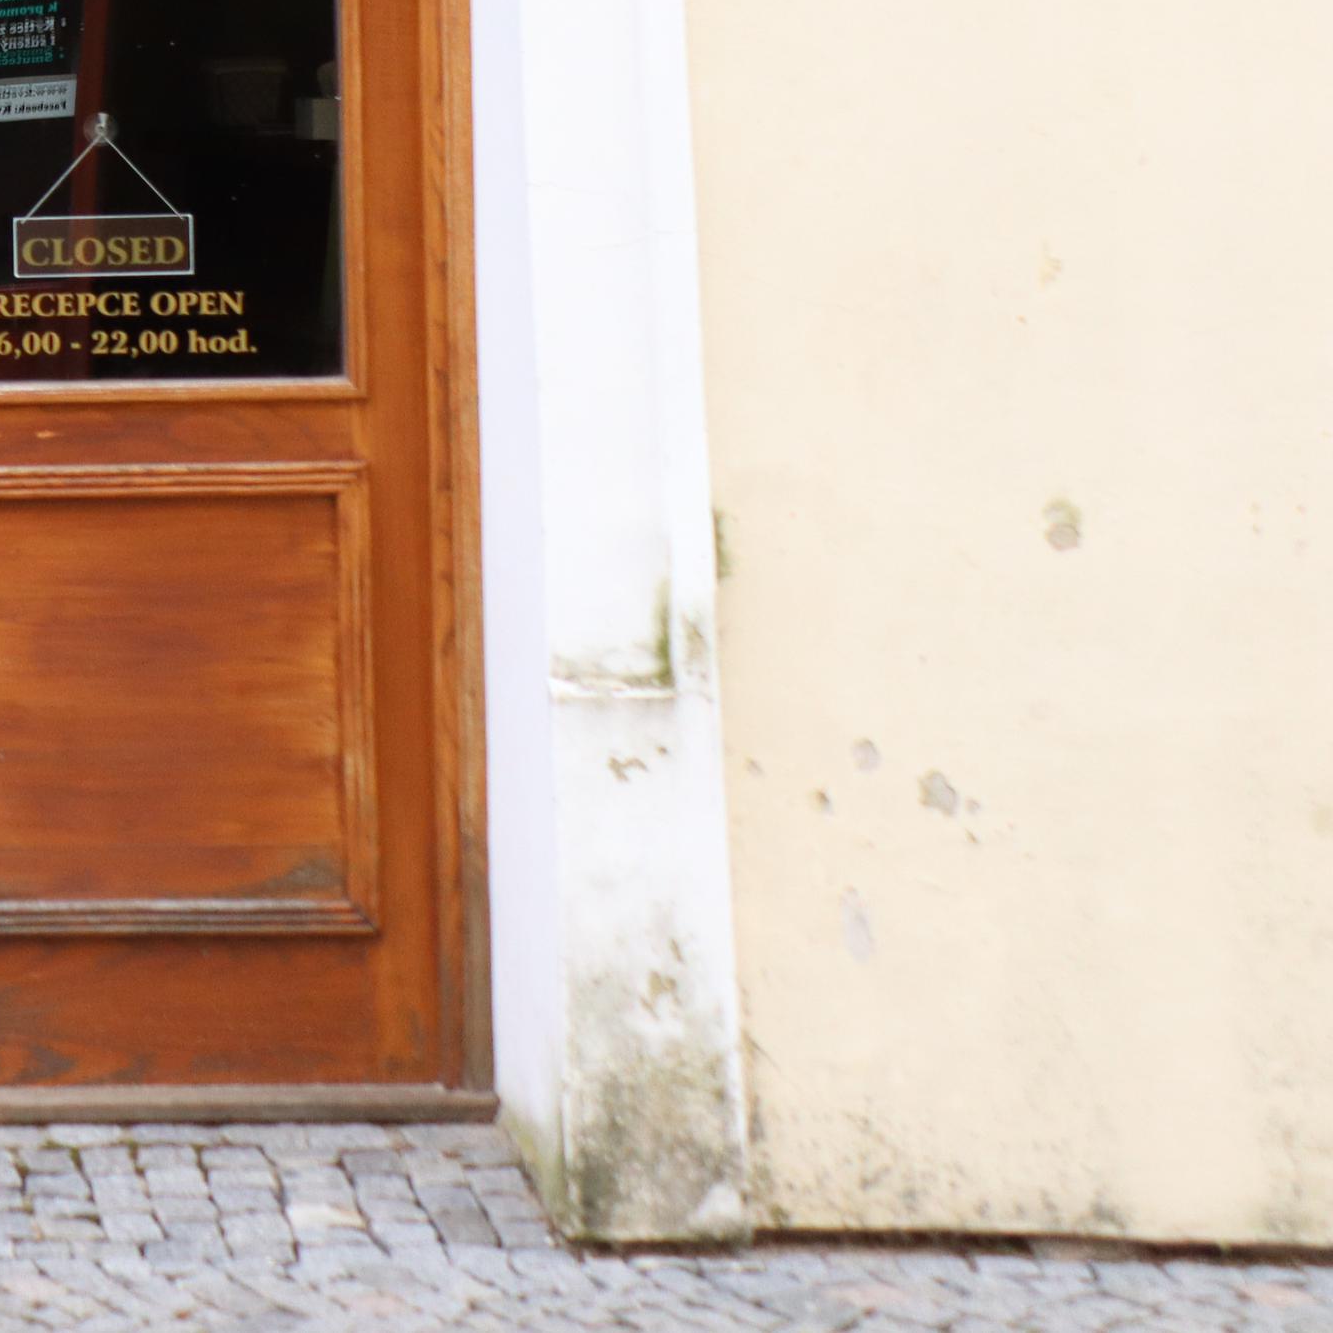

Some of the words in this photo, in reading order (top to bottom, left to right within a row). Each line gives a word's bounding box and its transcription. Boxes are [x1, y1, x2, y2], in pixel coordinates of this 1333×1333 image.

[21, 235, 186, 267] CLOSED
[149, 290, 245, 317] OPEN
[90, 329, 179, 359] 22,00
[187, 328, 258, 354] hod.
